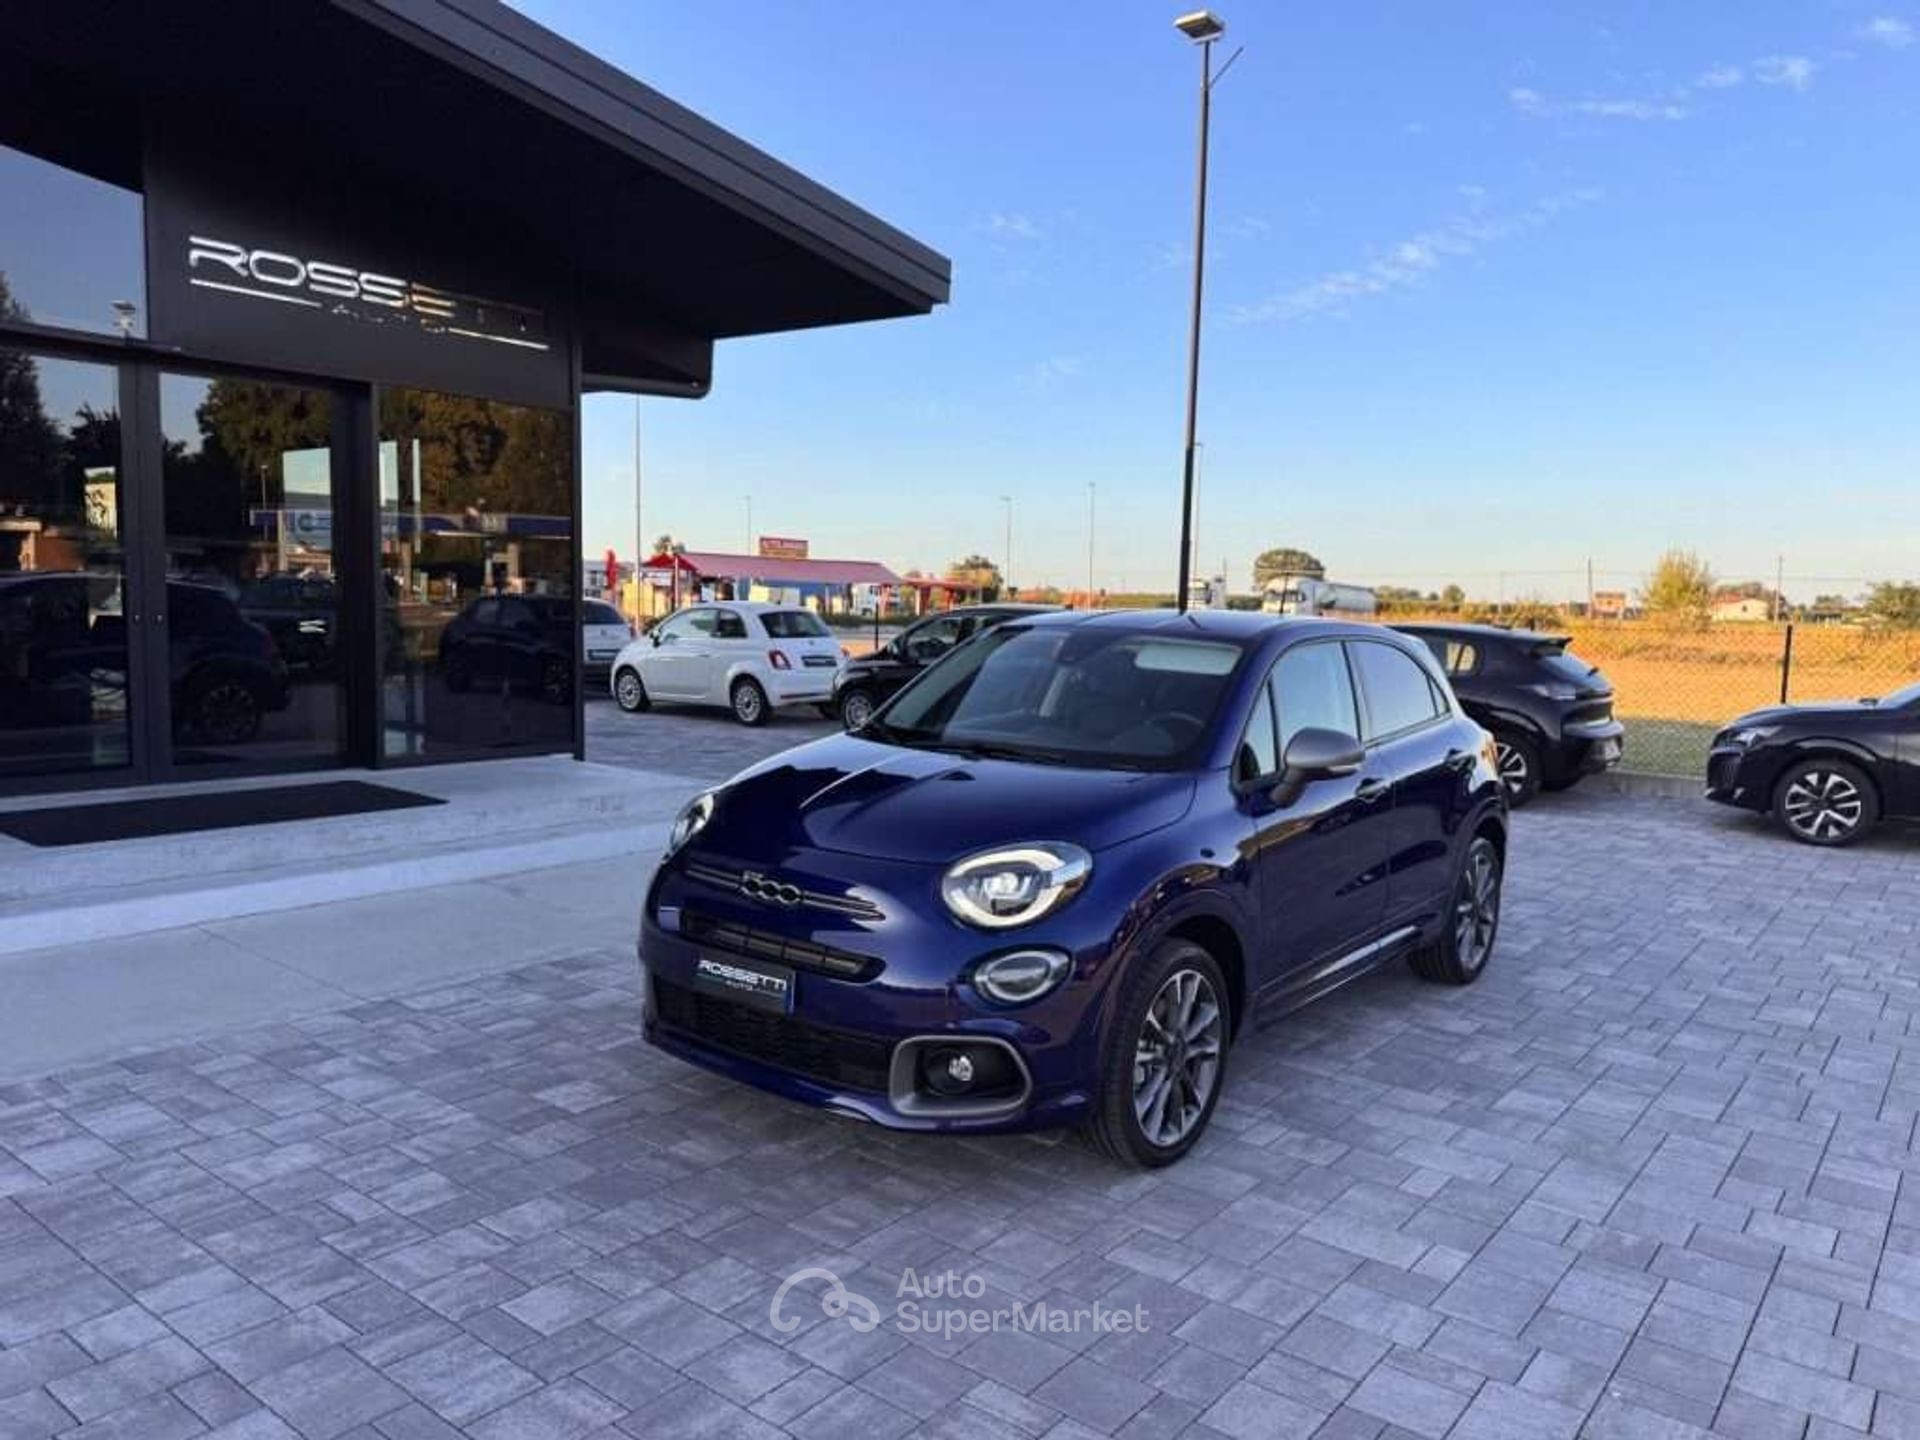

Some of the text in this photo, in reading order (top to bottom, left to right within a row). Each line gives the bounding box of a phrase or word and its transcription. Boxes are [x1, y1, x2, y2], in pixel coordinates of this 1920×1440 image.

[189, 235, 545, 335] ROSSE
[741, 870, 801, 904] 500
[698, 959, 788, 992] ROSSETTI
